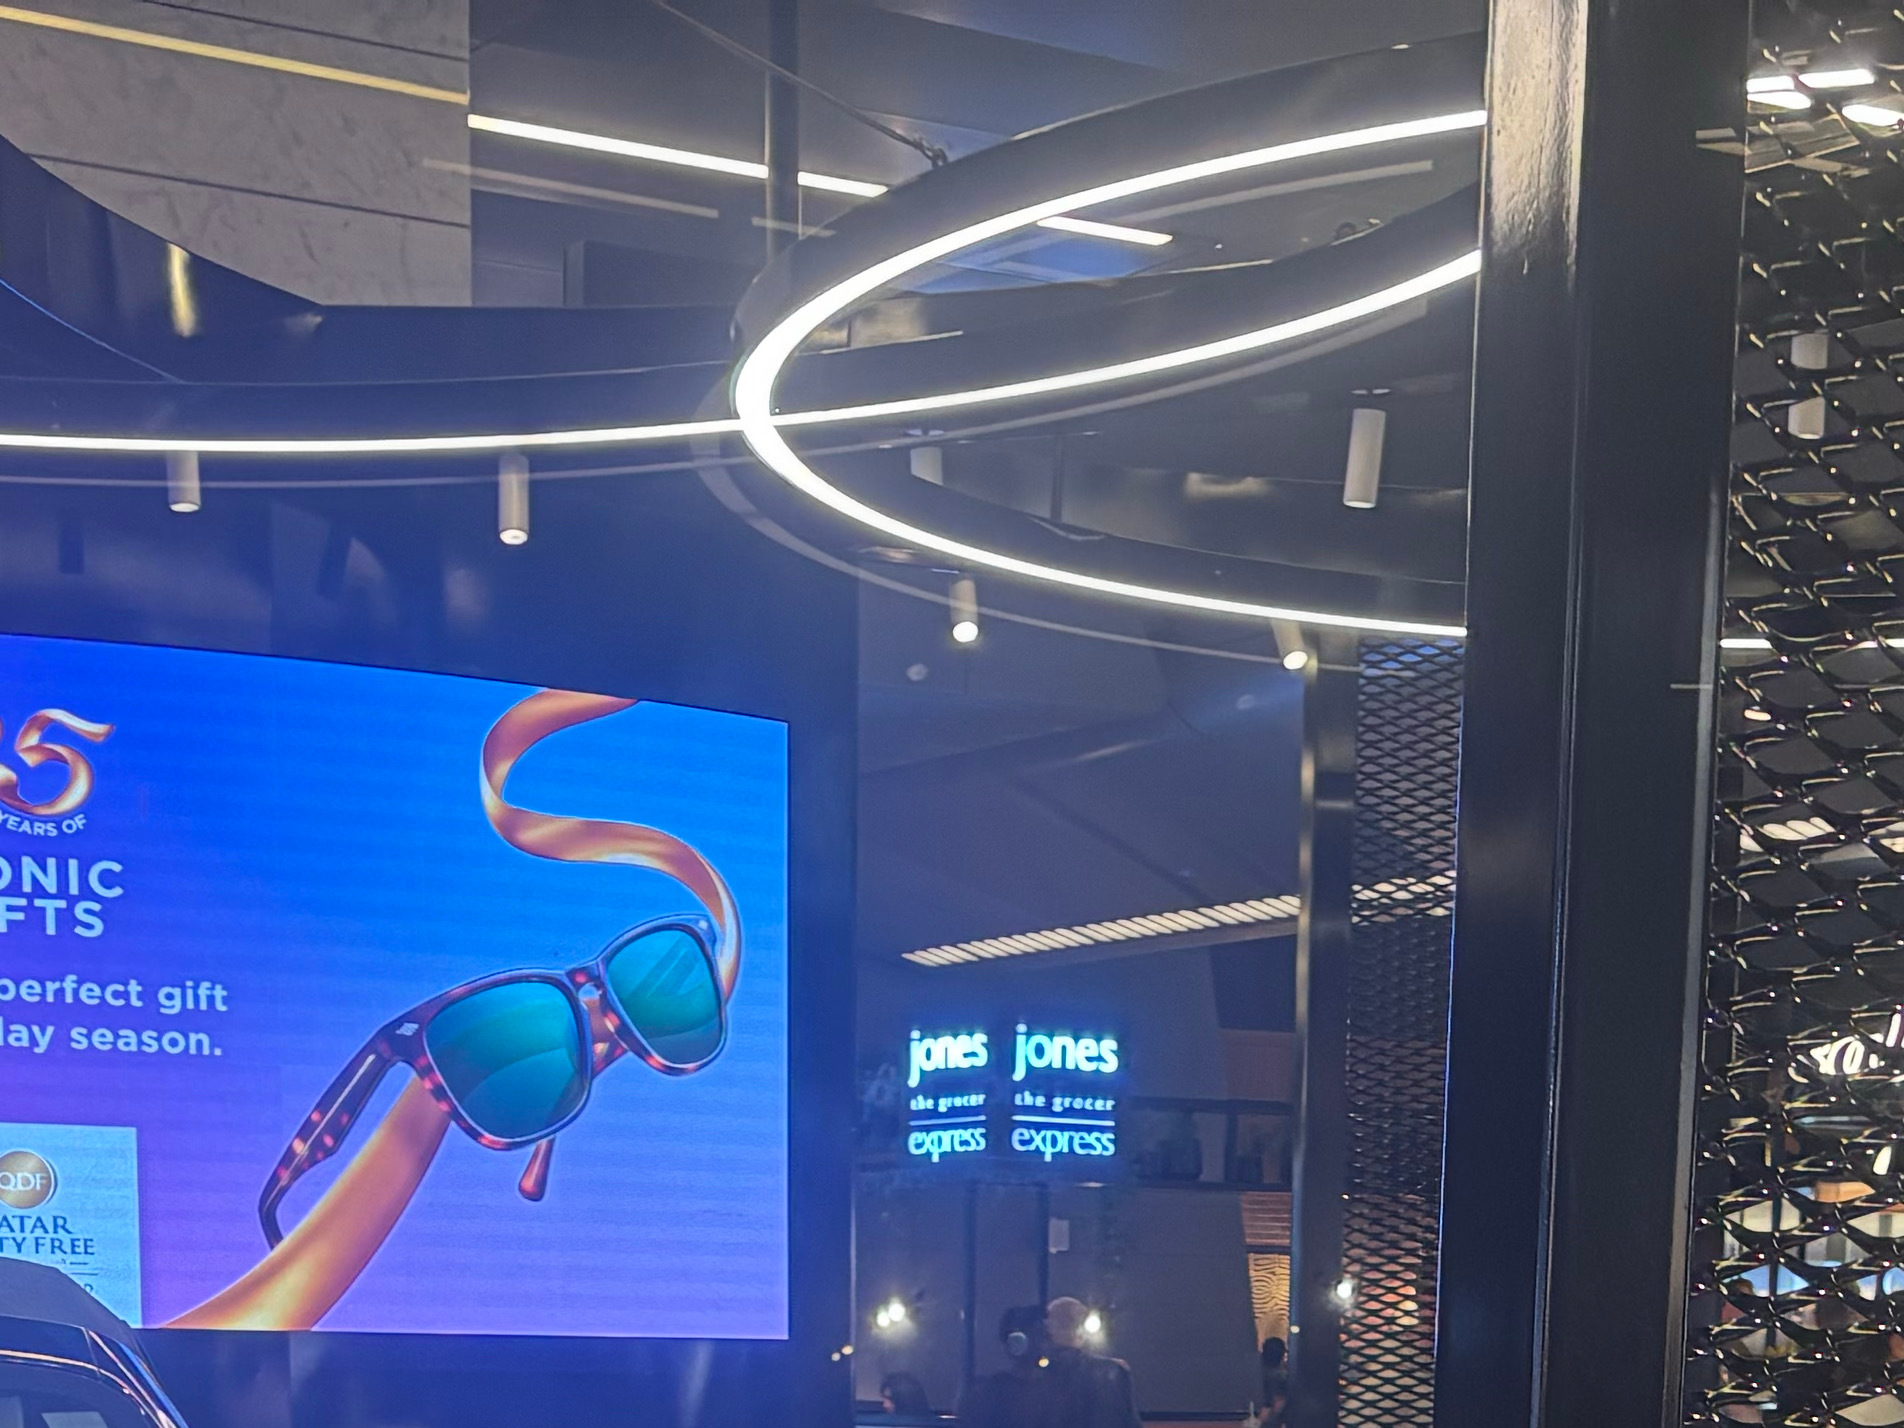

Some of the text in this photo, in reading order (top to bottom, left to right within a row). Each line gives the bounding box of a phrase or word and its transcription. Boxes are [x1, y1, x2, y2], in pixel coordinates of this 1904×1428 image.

[62, 813, 87, 834] OF
[158, 980, 229, 1015] gift
[70, 1024, 223, 1057] season.
[1011, 1023, 1119, 1081] jones
[907, 1029, 989, 1088] jones
[910, 1094, 934, 1111] the
[1014, 1090, 1116, 1113] the grocer
[908, 1127, 987, 1163] express
[1011, 1127, 1116, 1162] express
[34, 1236, 95, 1256] FREE
